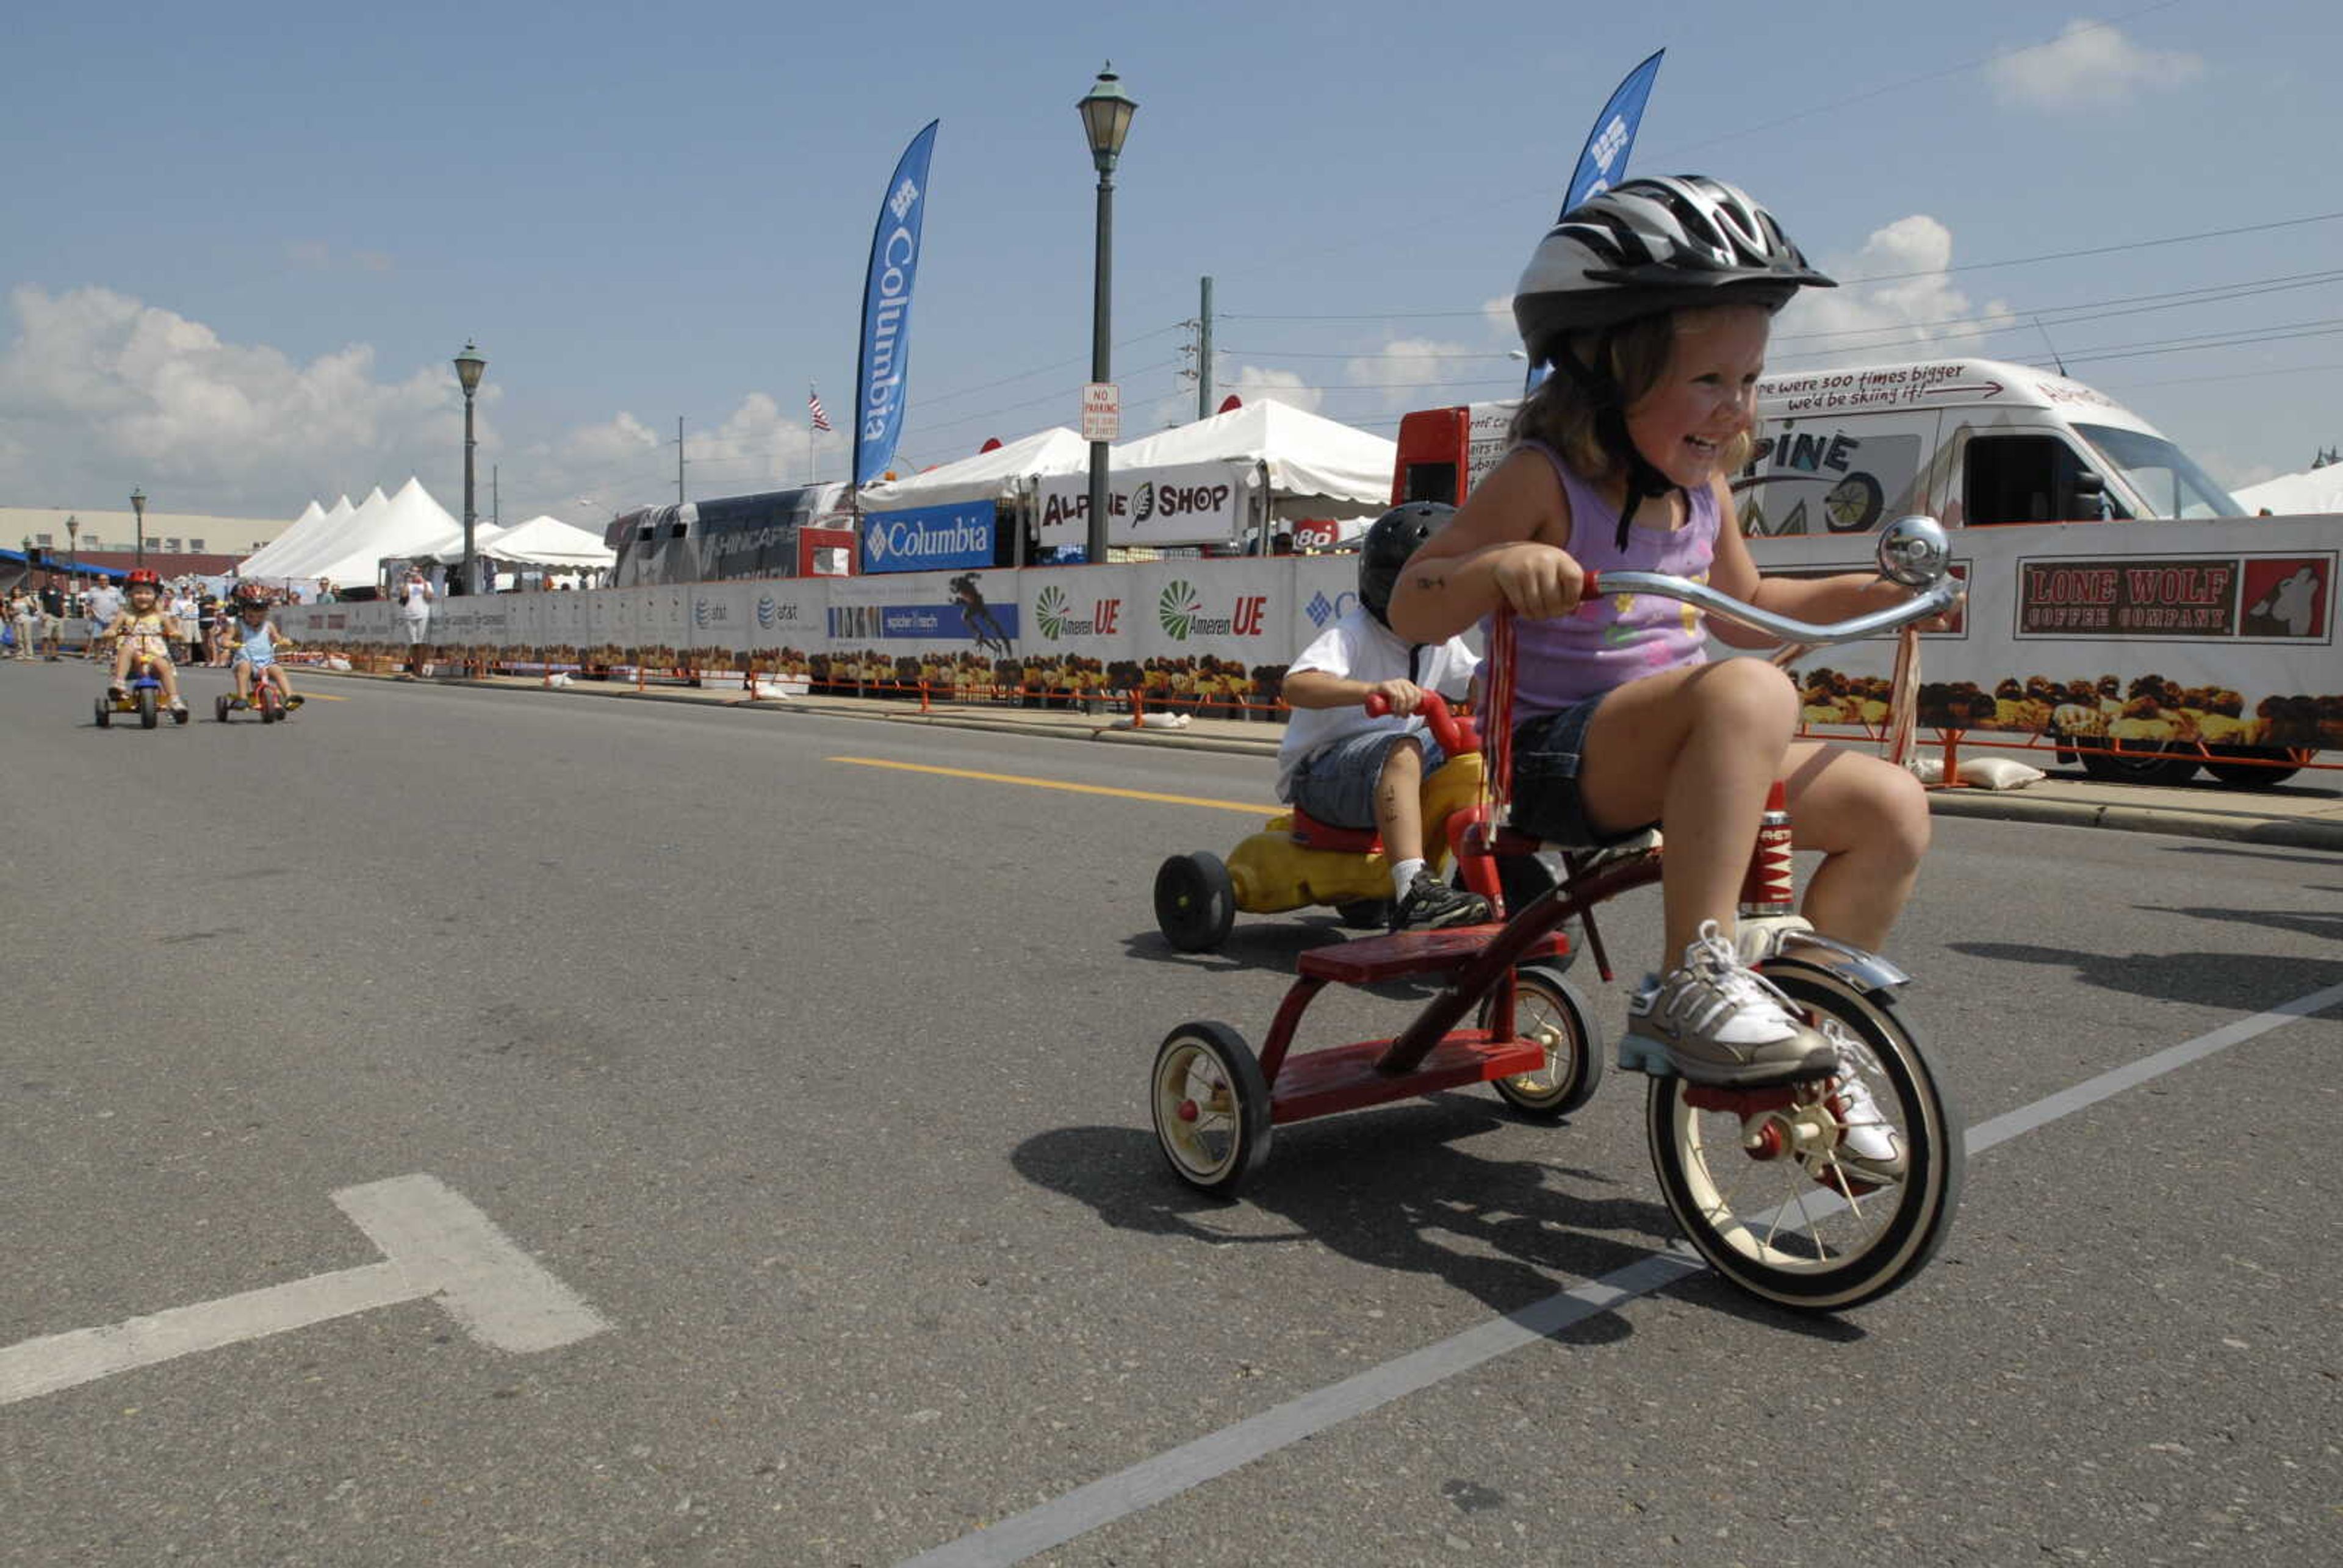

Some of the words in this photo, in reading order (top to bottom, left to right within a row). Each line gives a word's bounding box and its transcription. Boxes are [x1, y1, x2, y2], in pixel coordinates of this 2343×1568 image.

[863, 226, 914, 441] Columbia
[1093, 389, 1108, 401] NO
[1778, 380, 1818, 394] were
[1821, 375, 1854, 389] 300
[1858, 371, 1908, 388] times
[1911, 365, 1965, 384] bigger
[1788, 392, 1823, 411] we'd
[1827, 391, 1848, 407] be
[1850, 388, 1897, 405] skiing
[1743, 419, 1860, 478] PINE
[1042, 493, 1128, 527] ALPE
[1159, 484, 1229, 516] SHOP
[888, 516, 987, 556] Columbia
[2029, 569, 2119, 604] LONE
[2126, 567, 2229, 604] WOLF
[2027, 608, 2110, 628] COFFEE
[2118, 608, 2226, 628] COMPANY
